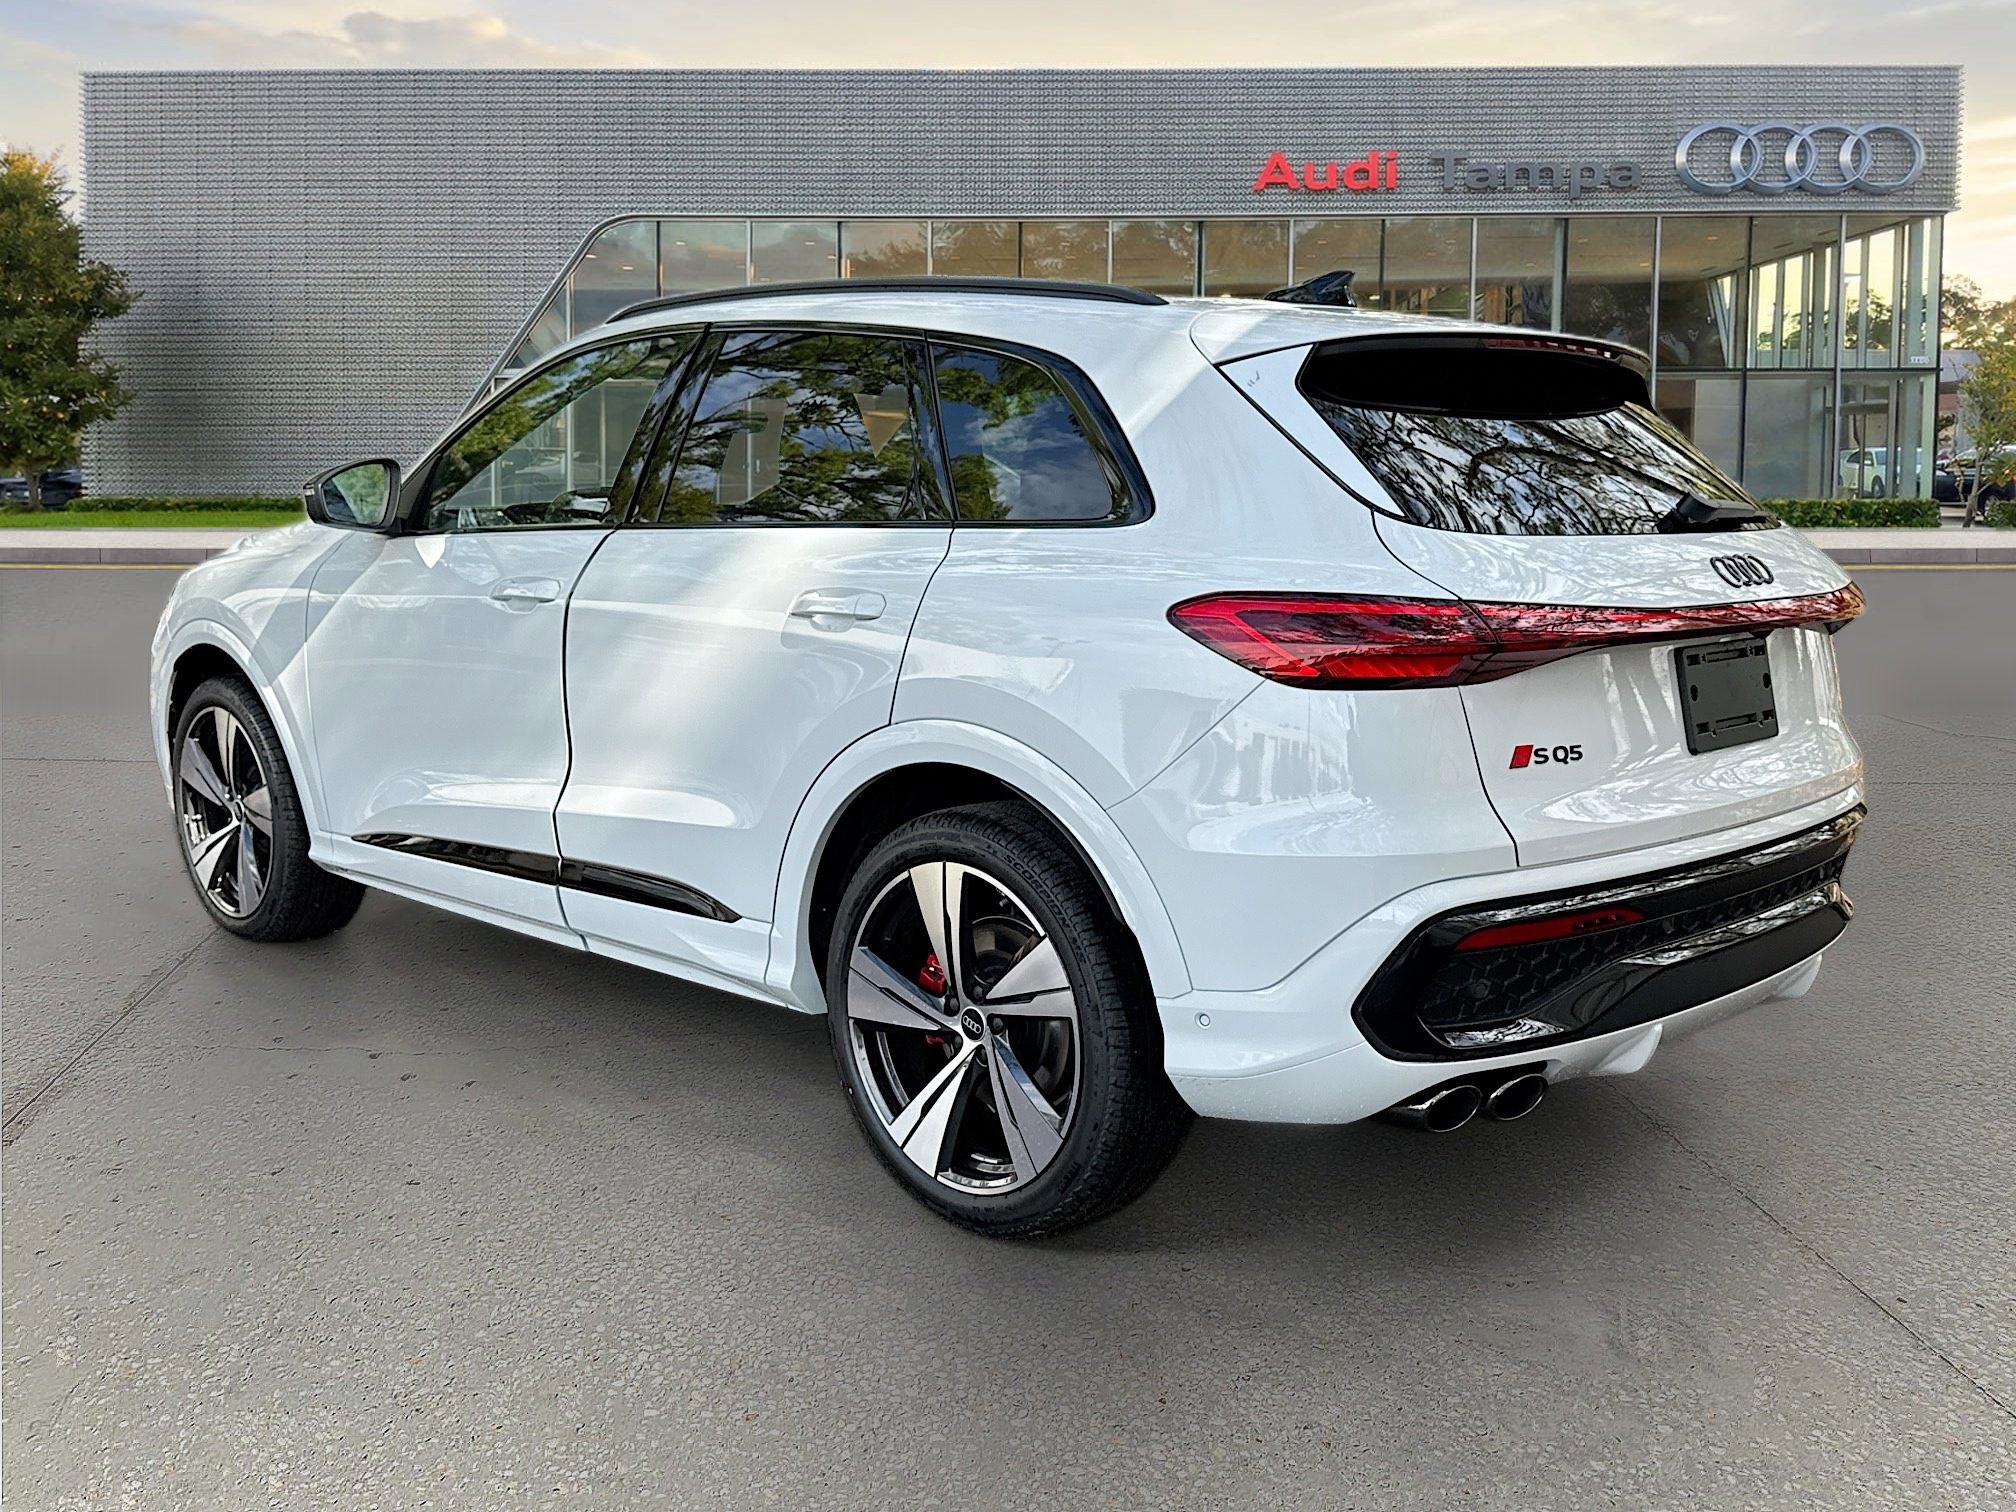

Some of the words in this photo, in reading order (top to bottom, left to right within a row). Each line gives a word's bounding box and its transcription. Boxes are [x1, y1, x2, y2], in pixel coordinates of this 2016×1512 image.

[1253, 149, 1397, 191] Audi
[1430, 150, 1643, 198] Tampa
[1533, 744, 1583, 764] SQ5
[1003, 854, 1072, 929] SCORPION
